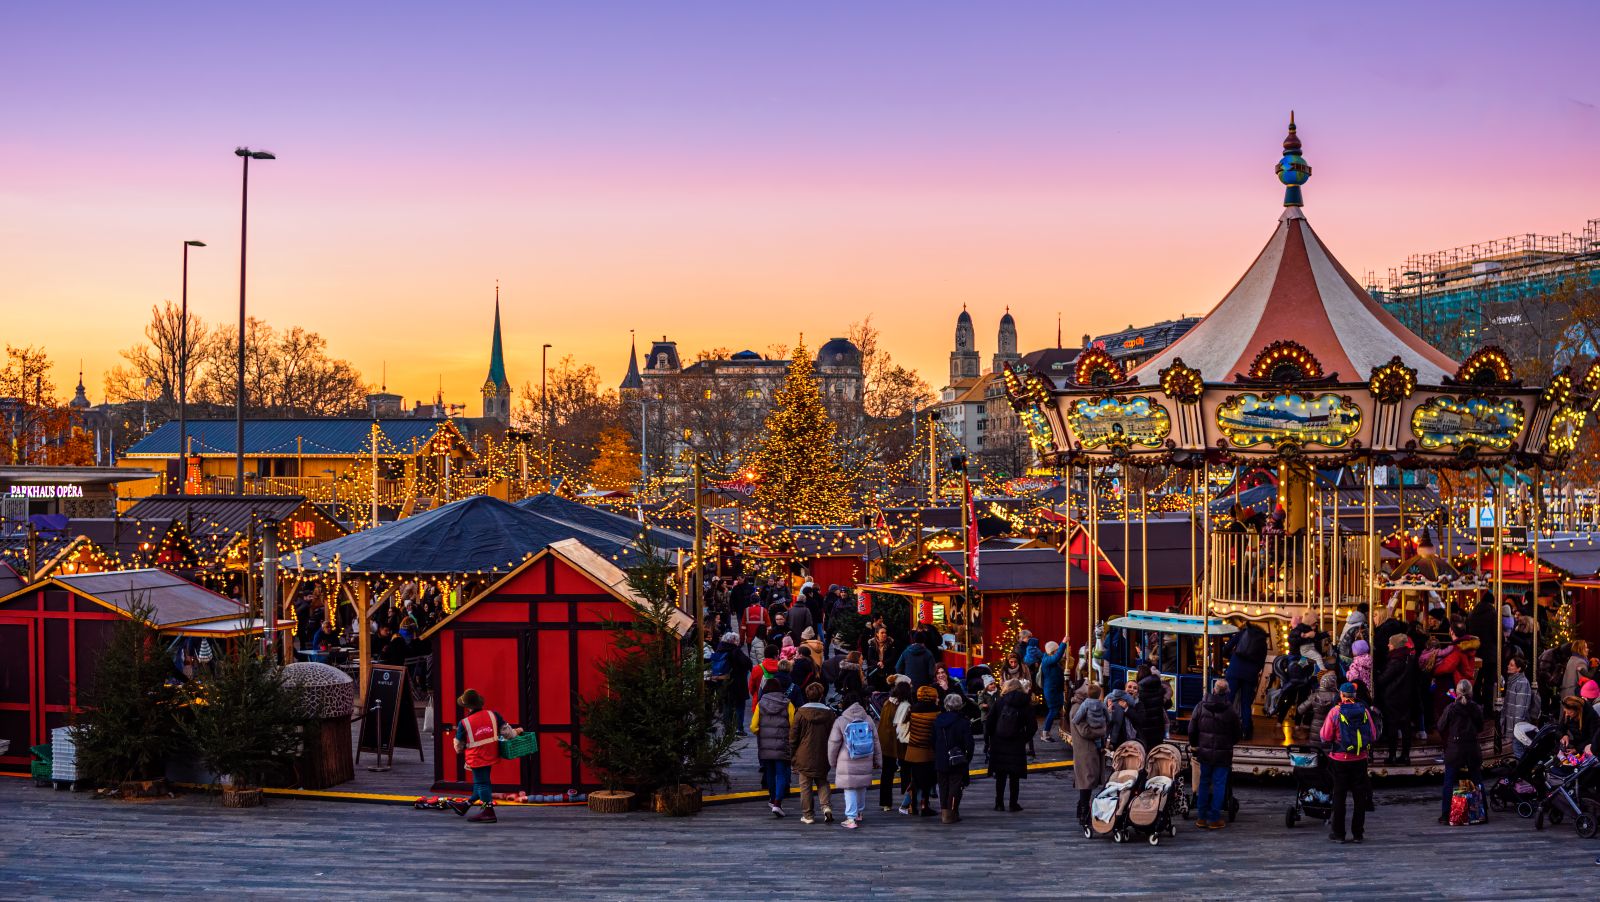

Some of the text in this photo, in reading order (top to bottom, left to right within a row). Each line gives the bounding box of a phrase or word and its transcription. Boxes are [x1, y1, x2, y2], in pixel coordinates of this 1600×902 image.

[10, 483, 83, 498] PARKHAUS OPÉRA
[294, 521, 315, 538] BAR
